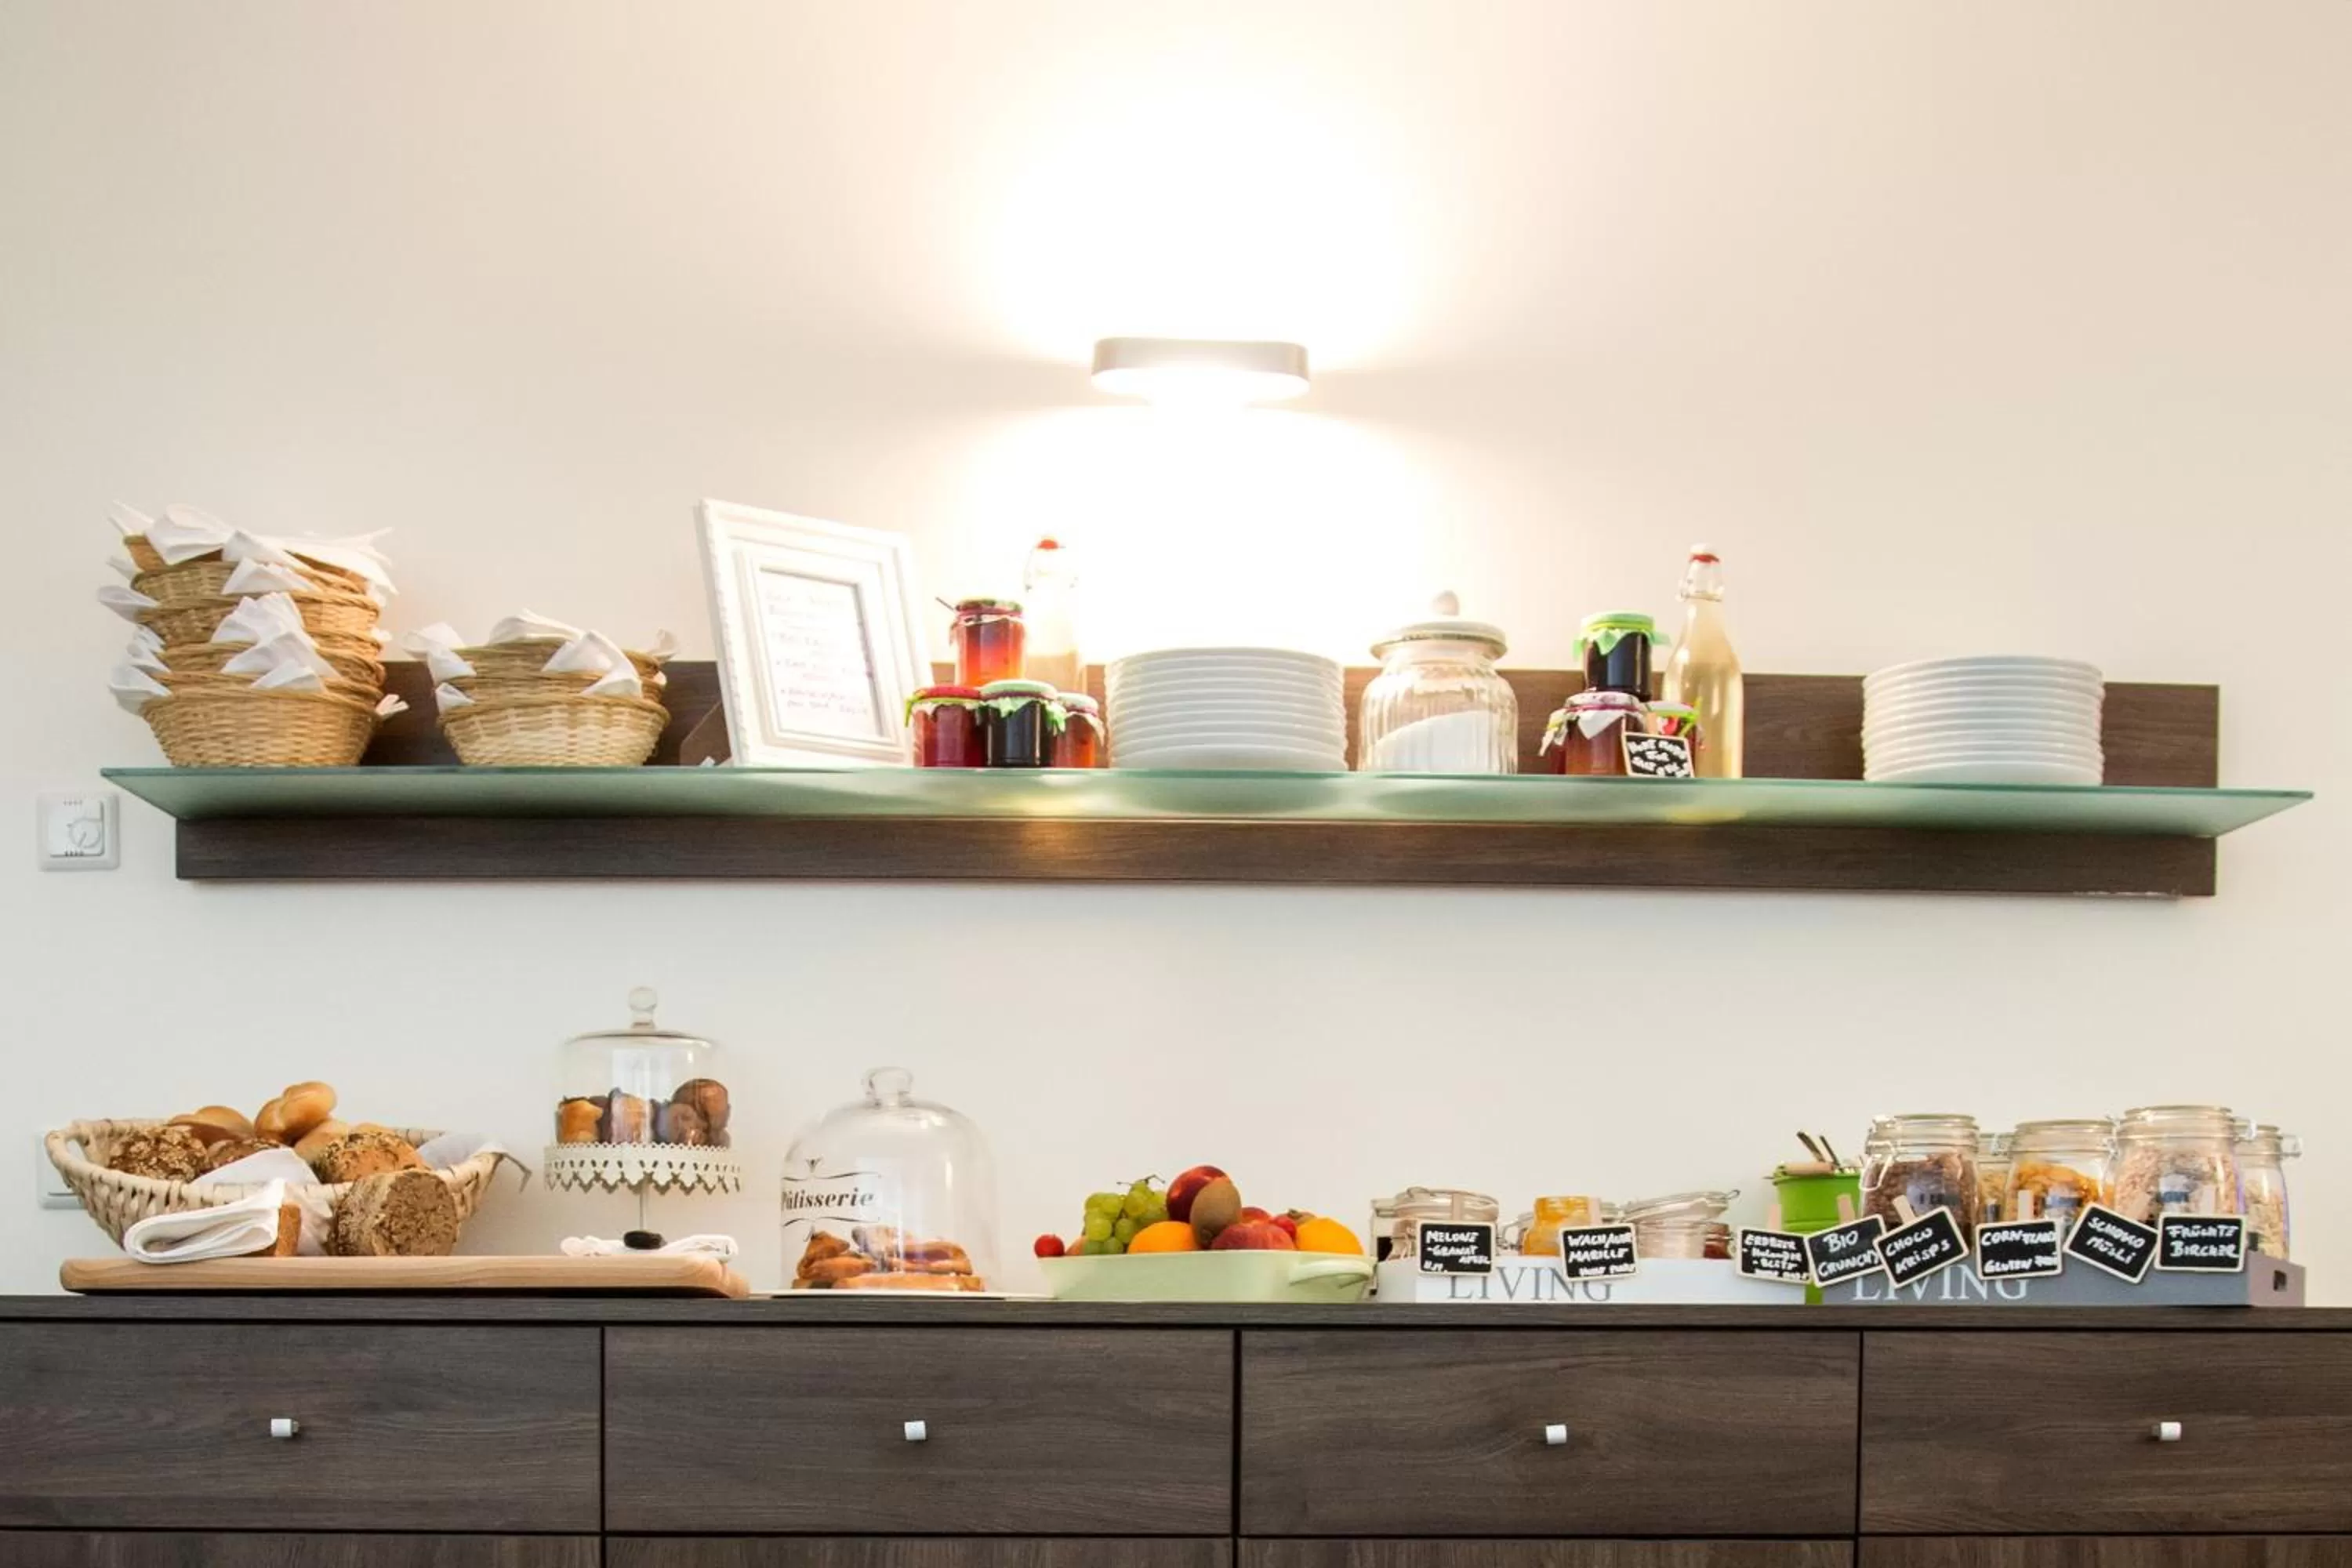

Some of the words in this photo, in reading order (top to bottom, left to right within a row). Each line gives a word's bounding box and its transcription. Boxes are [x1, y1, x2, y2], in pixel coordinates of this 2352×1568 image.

[1426, 1230, 1479, 1243] MELONE
[1823, 1230, 1860, 1253] BIO
[1886, 1227, 1933, 1257] CHOCO
[1446, 1266, 1613, 1301] LIVING
